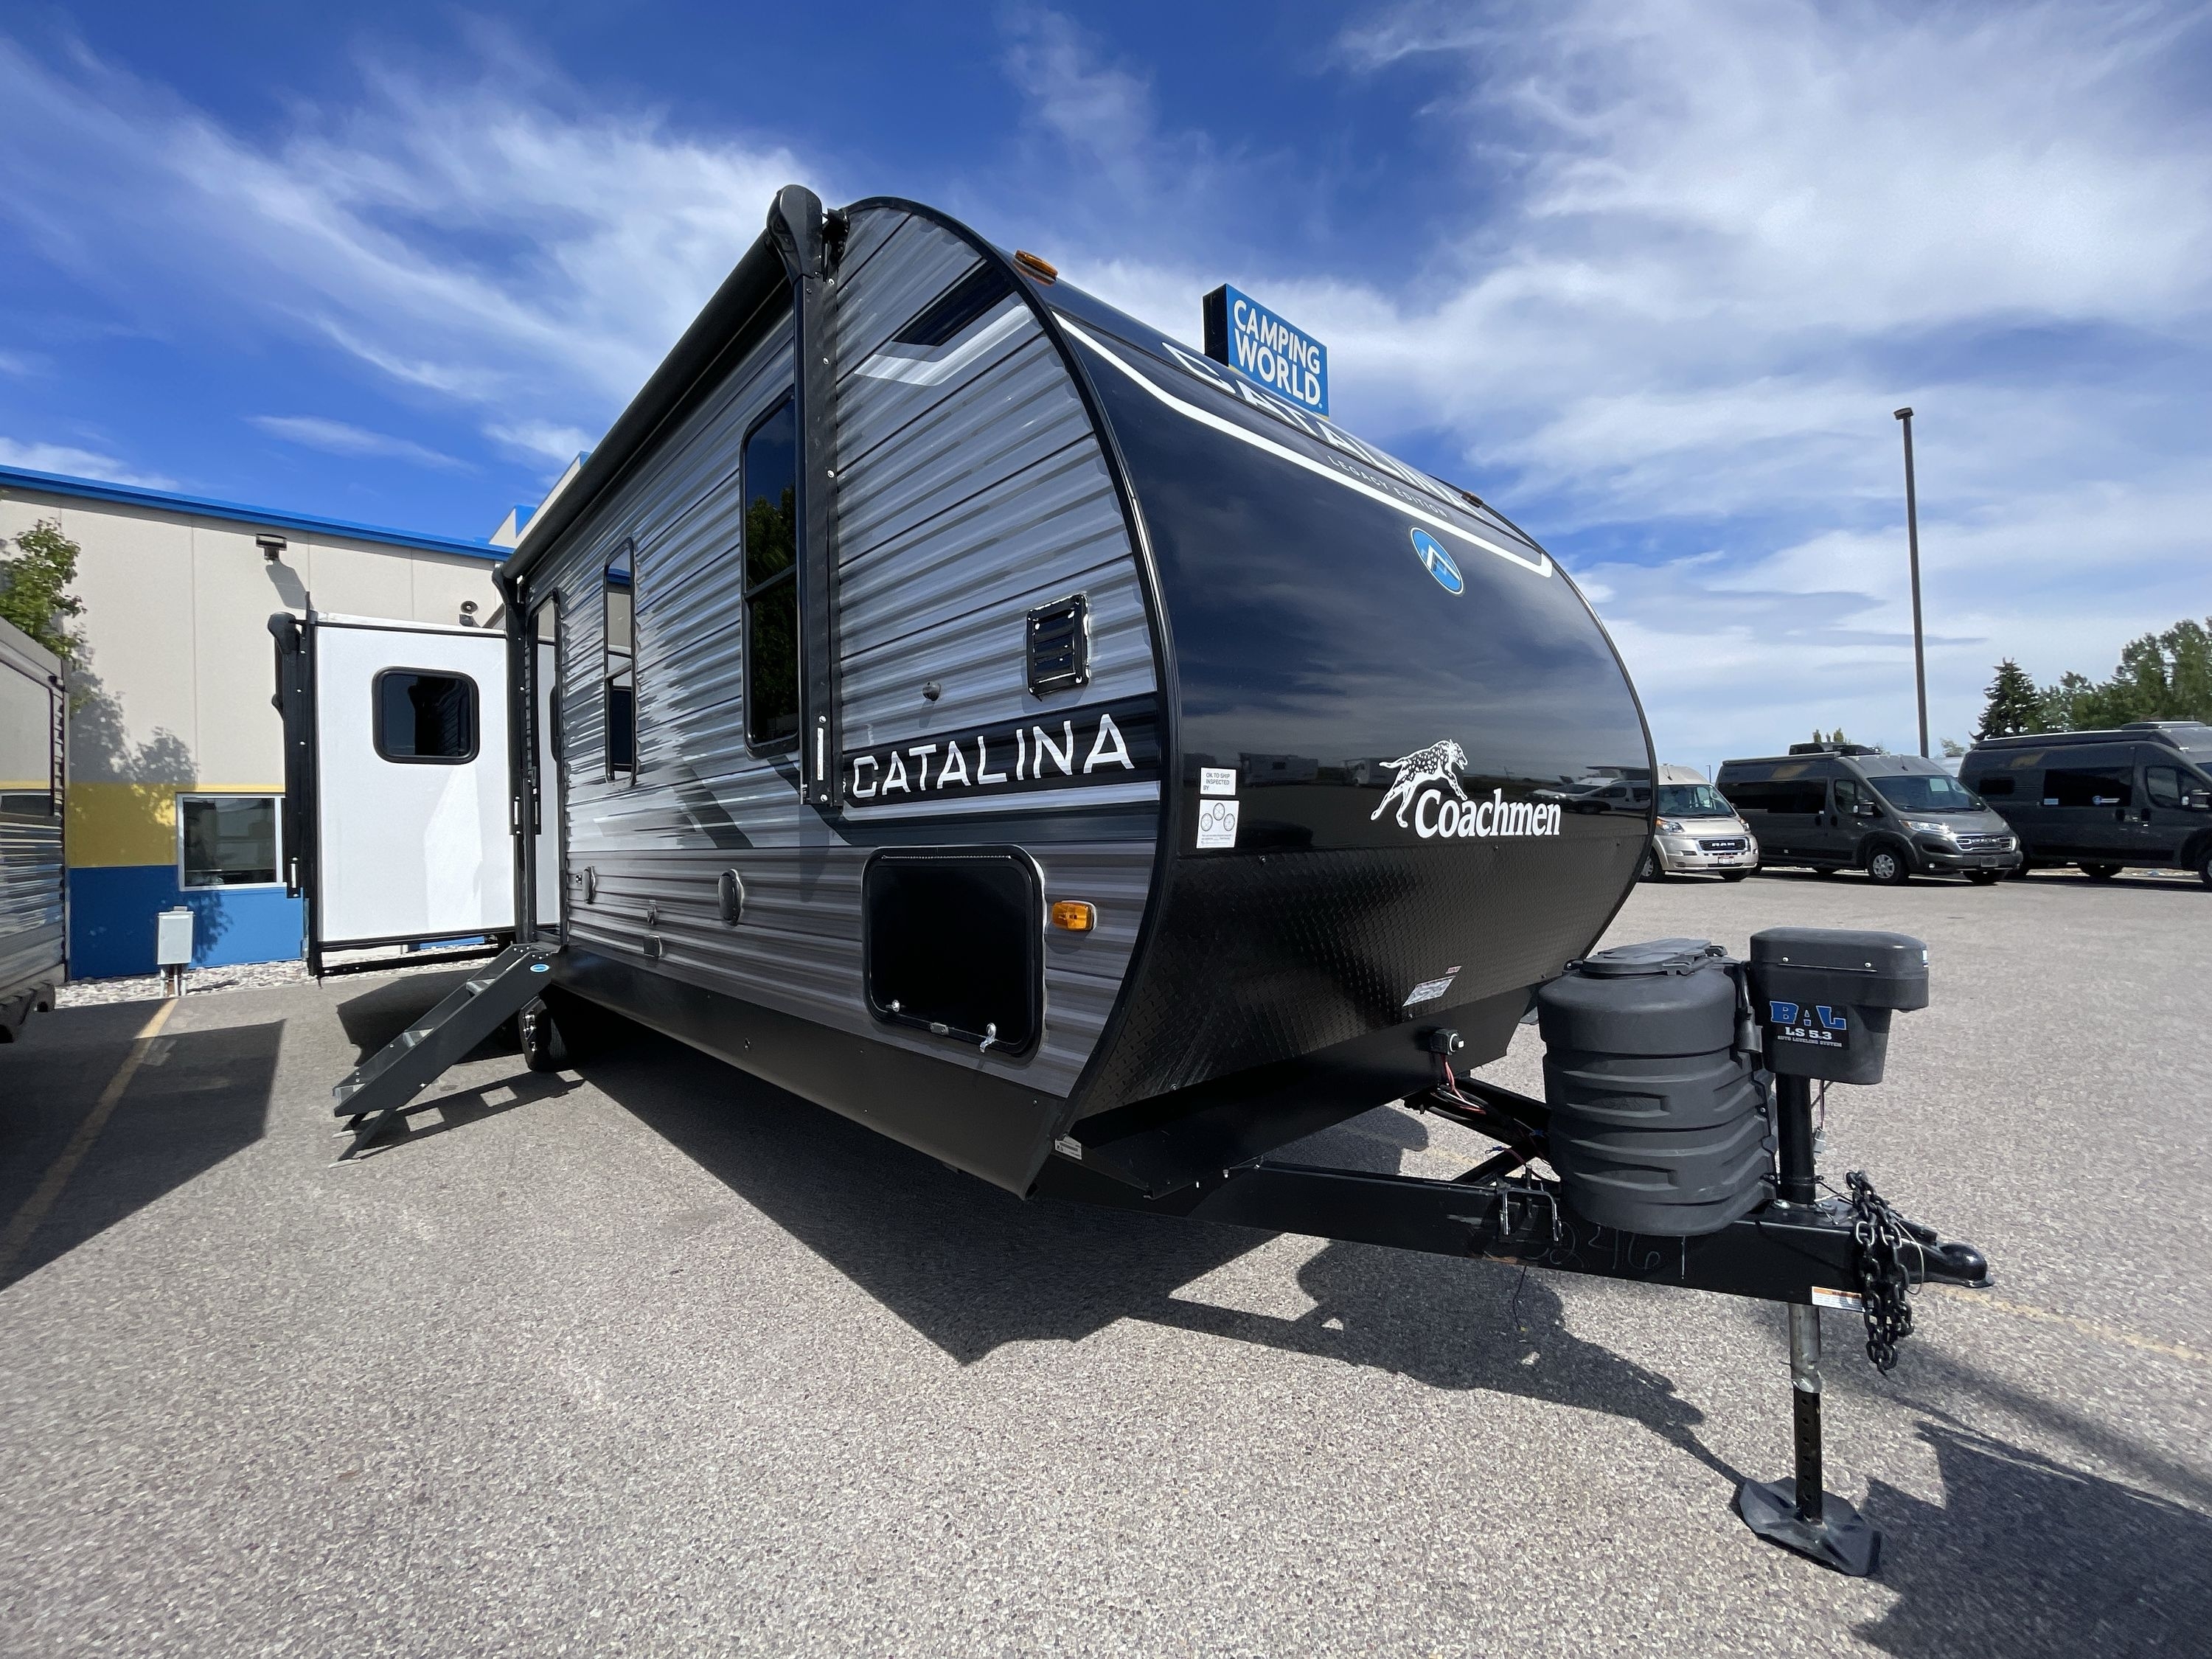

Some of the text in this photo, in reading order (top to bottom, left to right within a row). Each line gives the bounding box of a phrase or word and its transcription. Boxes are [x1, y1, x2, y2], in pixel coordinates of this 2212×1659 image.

[1234, 299, 1321, 375] CAMPING
[1234, 328, 1321, 406] WORLD
[1162, 342, 1485, 521] CATALINA
[1327, 455, 1448, 518] LEGACY EDITION
[852, 713, 1135, 799] CATALINA
[1414, 787, 1562, 839] Coachmen
[1785, 1026, 1832, 1040] LS 5.3
